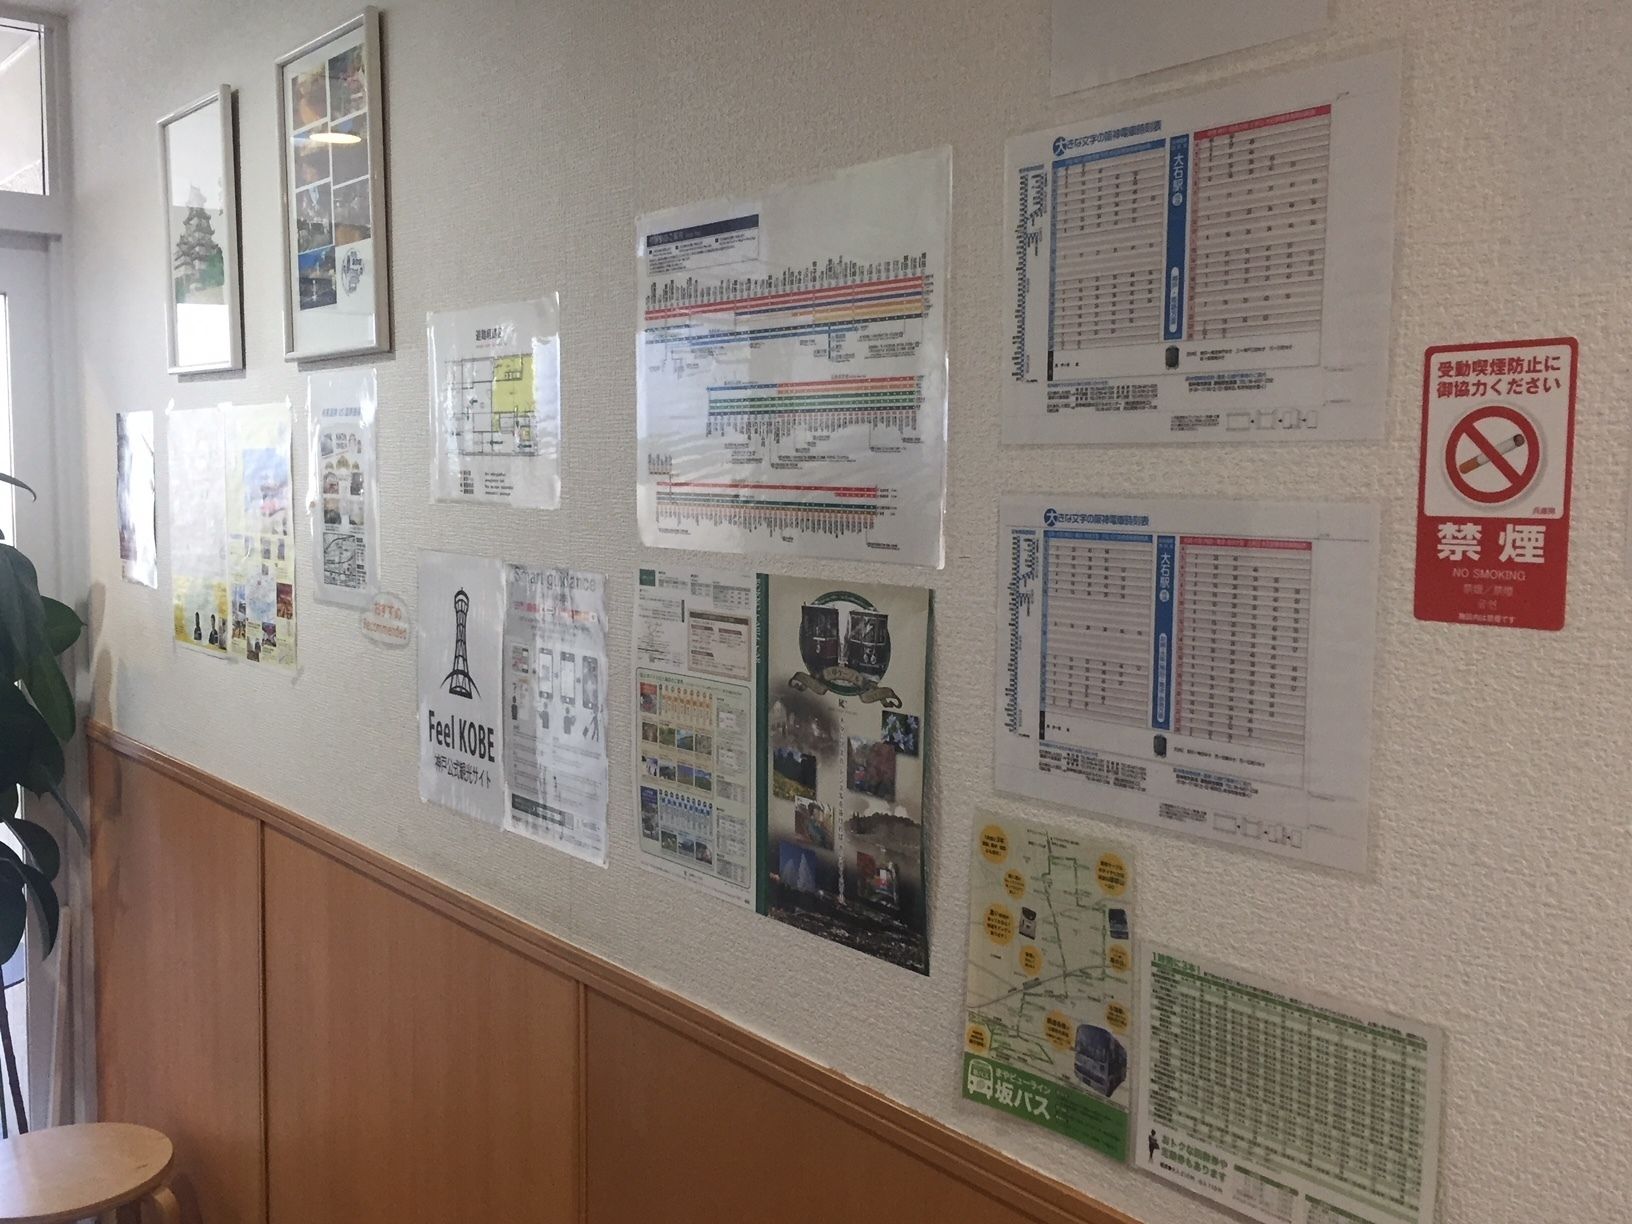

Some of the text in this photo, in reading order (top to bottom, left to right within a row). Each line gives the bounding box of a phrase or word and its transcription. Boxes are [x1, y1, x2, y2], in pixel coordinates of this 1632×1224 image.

[1437, 355, 1561, 378] 受動喫煙防止に
[1436, 377, 1561, 398] 御協力ください
[1453, 568, 1526, 581] NO SMOKING
[428, 709, 496, 763] Feel KOBE
[434, 753, 491, 789] 神戸公式観光サイト
[994, 1079, 1051, 1121] 坂バス
